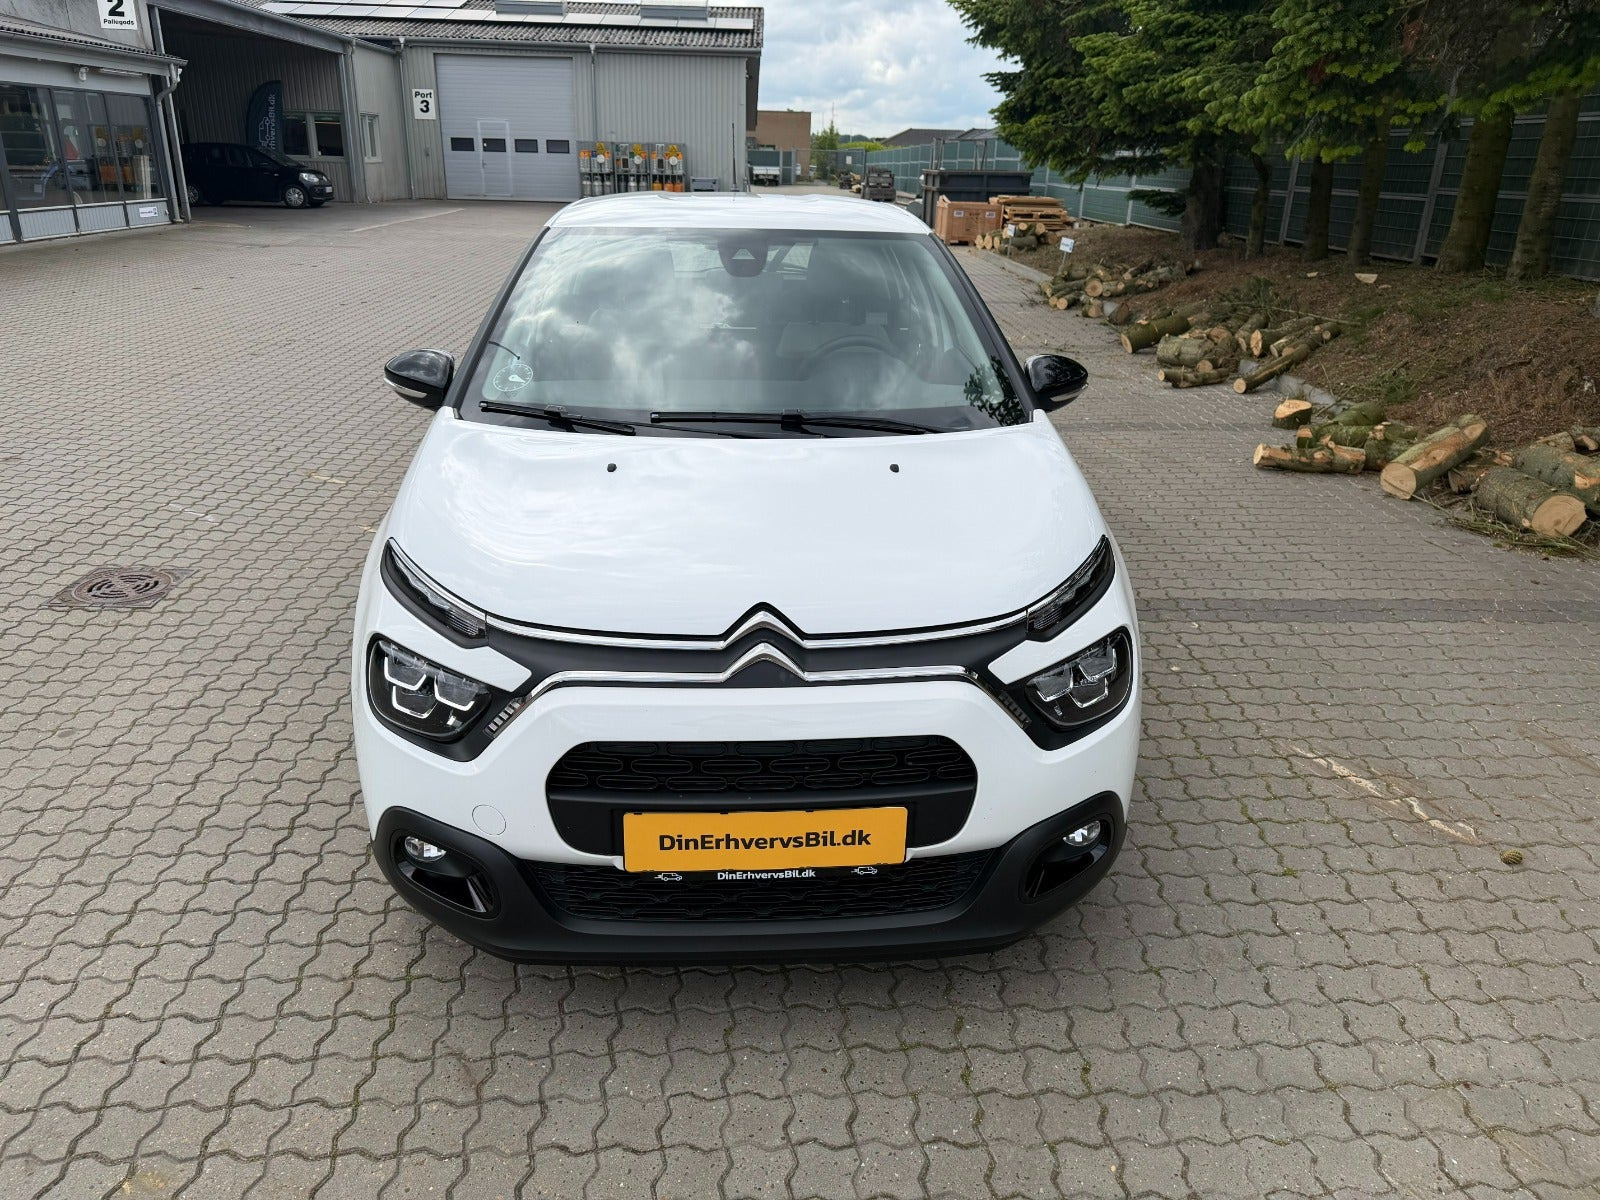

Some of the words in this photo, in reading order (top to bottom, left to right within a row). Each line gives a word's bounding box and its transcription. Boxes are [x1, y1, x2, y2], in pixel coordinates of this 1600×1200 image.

[107, 0, 125, 17] 2
[414, 91, 432, 99] Port
[419, 99, 430, 113] 3
[658, 829, 872, 851] DinErhvervsBil.dk
[717, 869, 816, 880] DinErhvervsBil.dk
